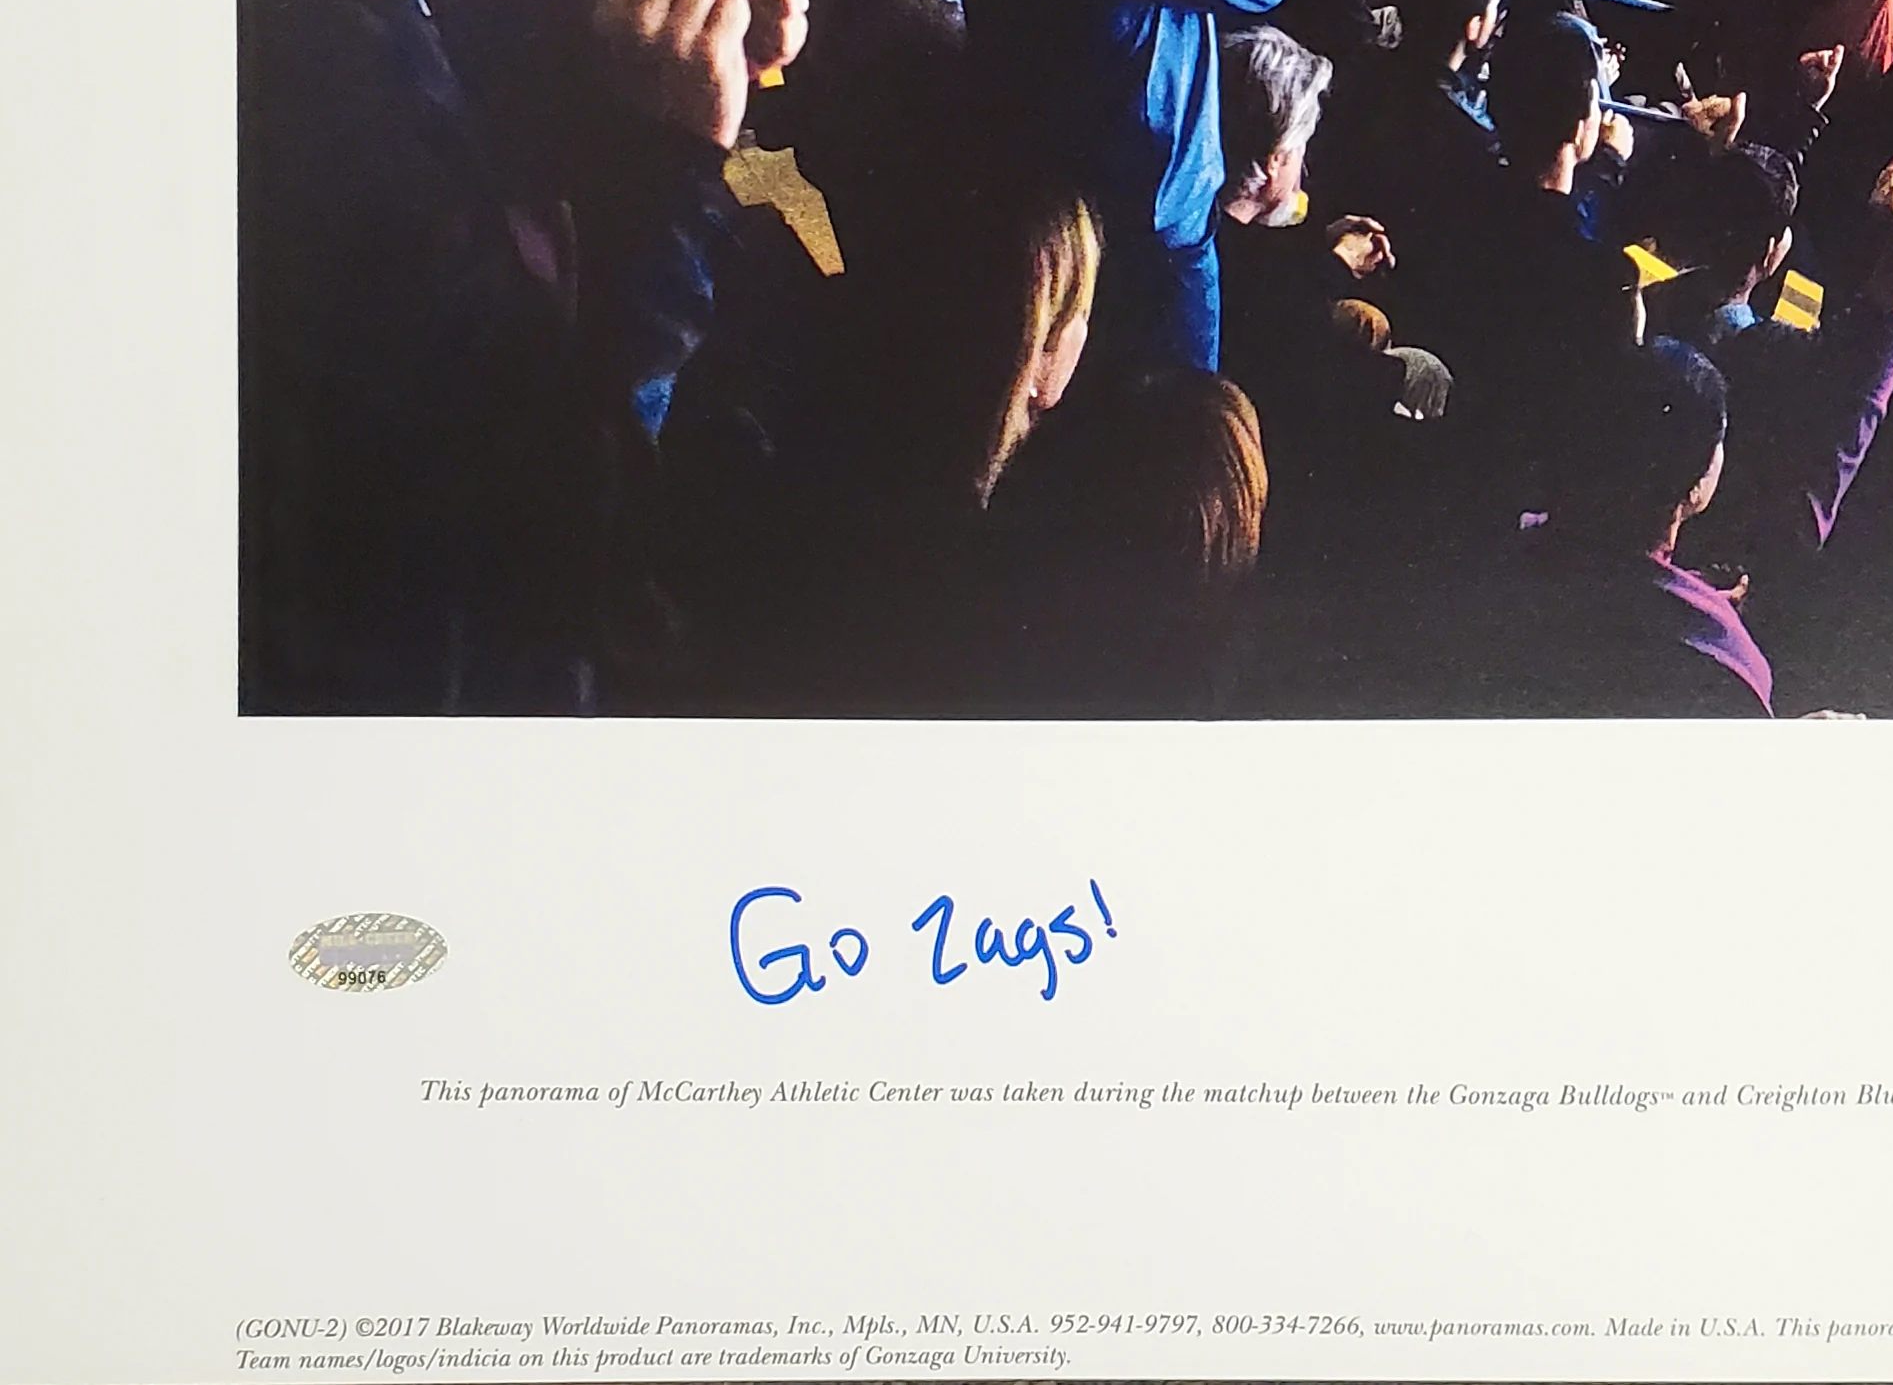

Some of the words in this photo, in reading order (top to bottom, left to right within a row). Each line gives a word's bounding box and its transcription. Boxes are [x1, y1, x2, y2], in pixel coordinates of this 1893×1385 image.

[730, 886, 869, 1005] Go
[337, 970, 387, 986] 99076
[420, 1079, 473, 1102] This
[477, 1082, 600, 1109] panorama
[607, 1080, 635, 1109] of
[636, 1080, 763, 1110] McCarthey
[769, 1080, 861, 1102] Athletic
[868, 1080, 945, 1102] Center
[949, 1087, 995, 1102] was
[1002, 1080, 1065, 1102] taken
[1073, 1080, 1156, 1110] during
[1161, 1081, 1196, 1103] the
[1203, 1082, 1303, 1111] matchup
[1311, 1082, 1398, 1105] between
[1407, 1083, 1441, 1105] the
[1449, 1083, 1550, 1113] Gonzaga
[1681, 1084, 1728, 1106] and
[1737, 1084, 1846, 1112] Creighton
[235, 1317, 348, 1343] (GONU-2)
[355, 1316, 431, 1338] ©2017
[435, 1316, 534, 1343] Blakeway
[542, 1315, 651, 1336] Worldwide
[654, 1315, 779, 1339] Panoramas,
[786, 1315, 834, 1338] Inc.,
[841, 1314, 907, 1342] Mpls.,
[915, 1314, 963, 1338] MN,
[973, 1314, 1039, 1334] U.S.A.
[1049, 1313, 1202, 1337] 952-941-9797,
[1211, 1314, 1365, 1338] 800-334-7266,
[1373, 1318, 1596, 1342] www.panoramas.com.
[1604, 1317, 1664, 1337] Made
[1670, 1318, 1690, 1337] in
[1700, 1317, 1765, 1337] U.S.A.
[1775, 1317, 1820, 1337] This
[236, 1349, 291, 1370] Team
[298, 1347, 512, 1374] names/logos/indicia
[518, 1353, 545, 1367] on
[551, 1346, 591, 1367] this
[593, 1346, 674, 1374] product
[680, 1352, 713, 1366] are
[718, 1345, 833, 1366] trademarks
[838, 1345, 863, 1372] of
[865, 1345, 955, 1371] Gonzaga
[964, 1344, 1071, 1372] University.
